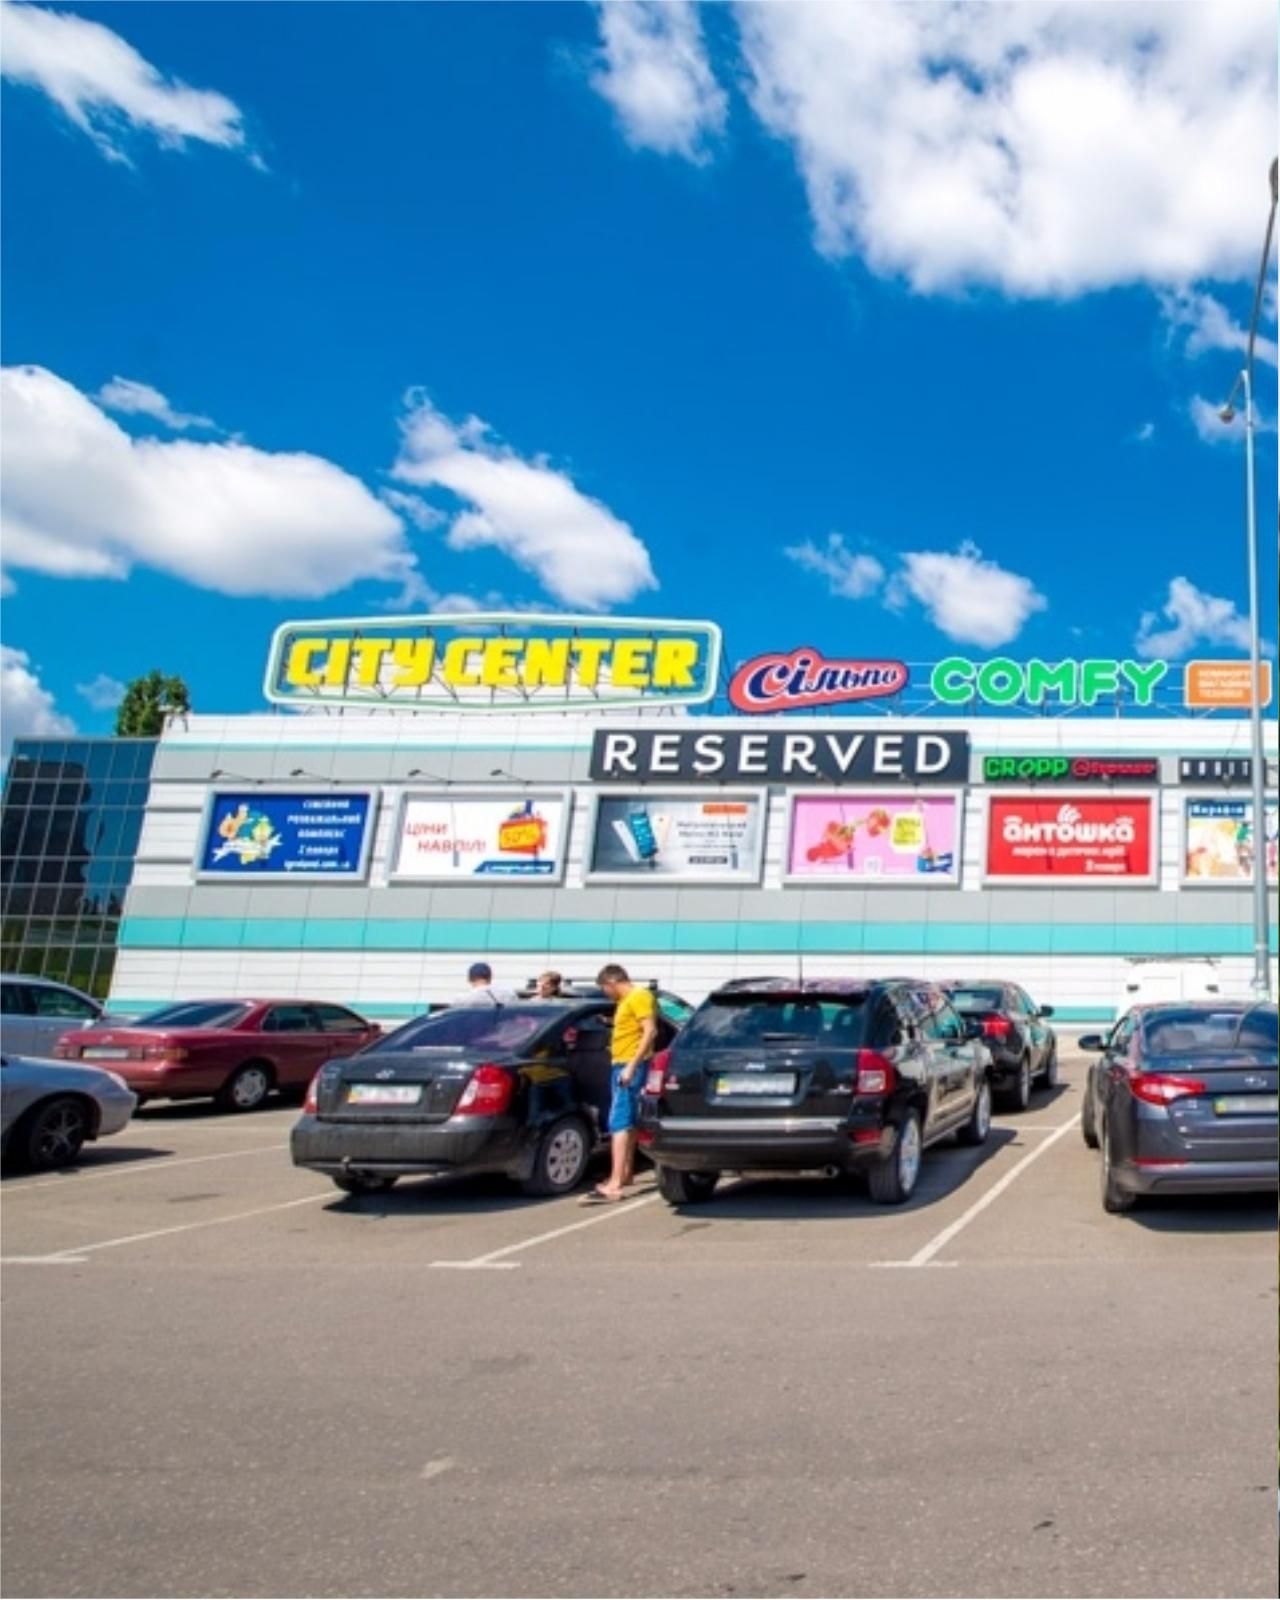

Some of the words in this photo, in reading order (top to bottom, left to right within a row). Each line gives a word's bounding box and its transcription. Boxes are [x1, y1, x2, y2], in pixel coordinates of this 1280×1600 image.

[286, 638, 434, 686] CITY
[442, 638, 699, 687] CENTER
[747, 659, 899, 700] Сільпо
[932, 657, 1168, 706] COMFY
[602, 733, 952, 774] RESERVED
[986, 758, 1068, 777] CROPP
